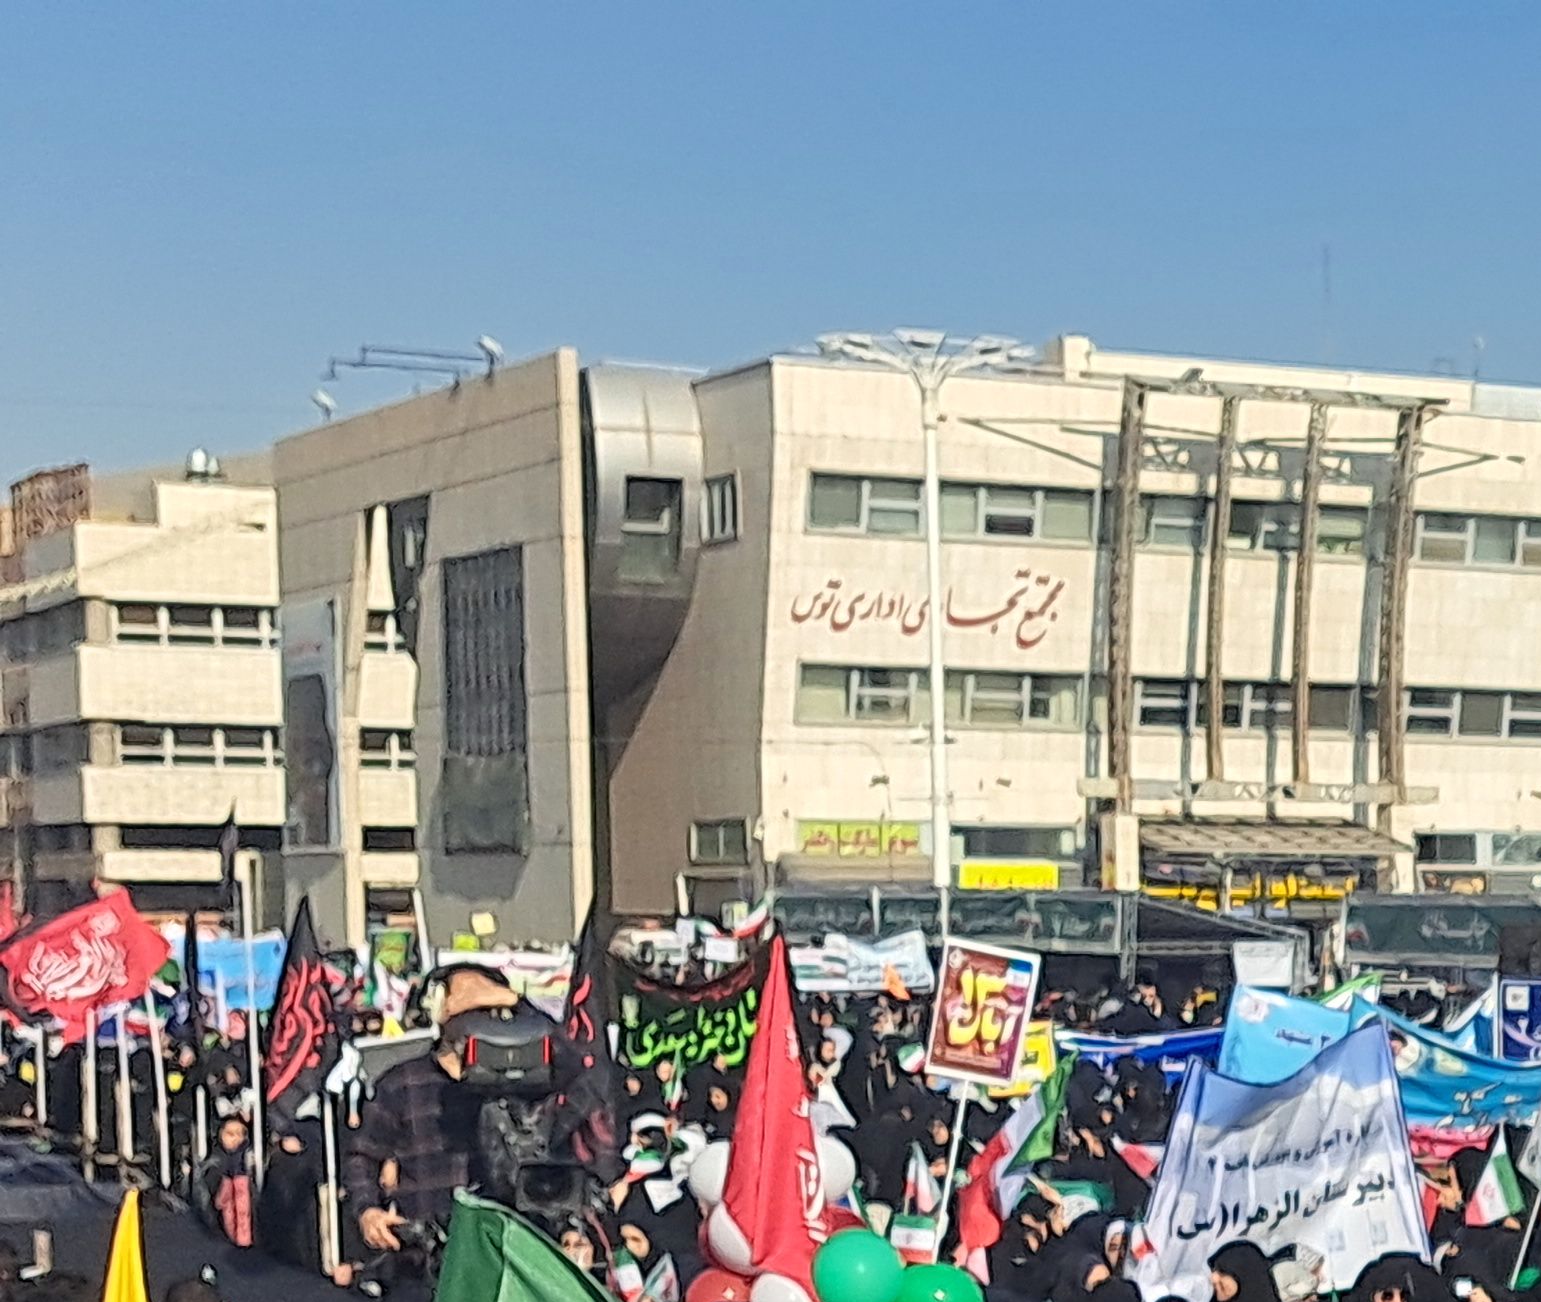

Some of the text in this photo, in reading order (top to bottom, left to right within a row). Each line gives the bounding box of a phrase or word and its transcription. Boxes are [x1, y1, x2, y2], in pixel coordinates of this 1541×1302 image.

[790, 568, 1064, 649] مجتمع تجای اداری توس
